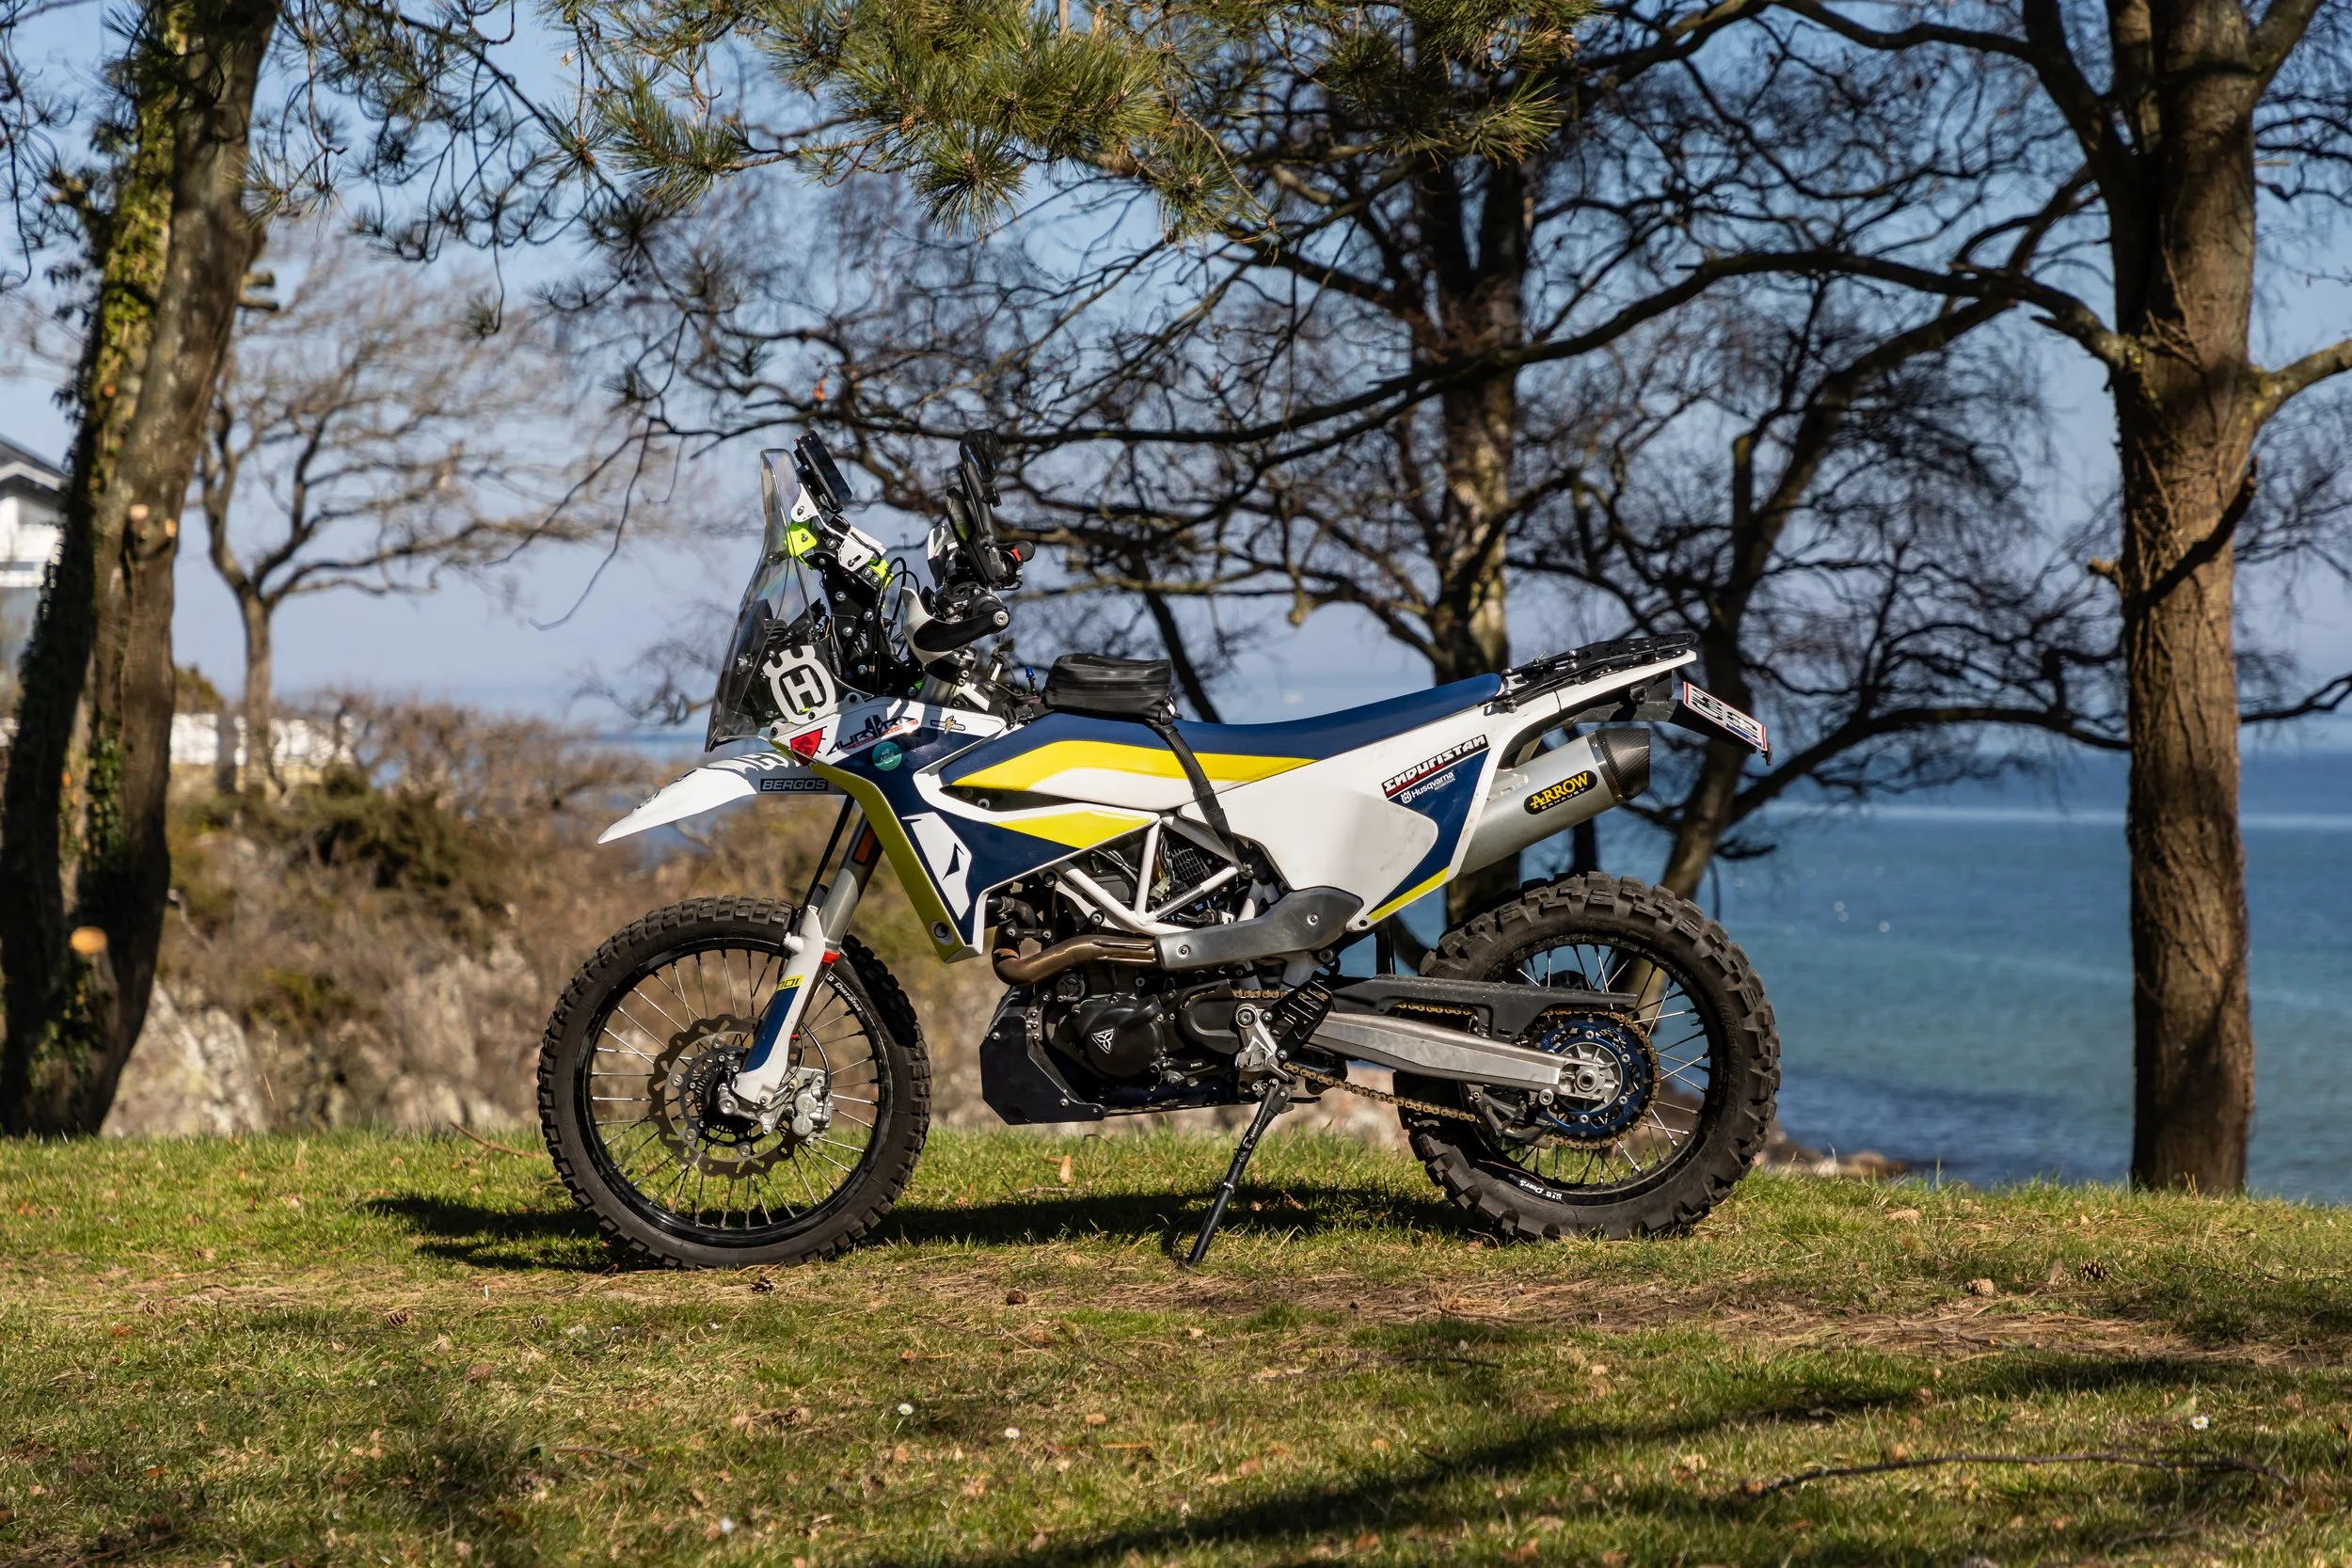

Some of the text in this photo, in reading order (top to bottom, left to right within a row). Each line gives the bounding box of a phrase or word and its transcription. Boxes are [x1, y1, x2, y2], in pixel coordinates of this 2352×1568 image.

[1382, 735, 1486, 793] ENDURISTAN
[762, 780, 826, 790] BERGOS
[1411, 771, 1454, 799] Husqvarna
[1530, 771, 1588, 809] ARROW
[1541, 787, 1585, 809] EXHAUST
